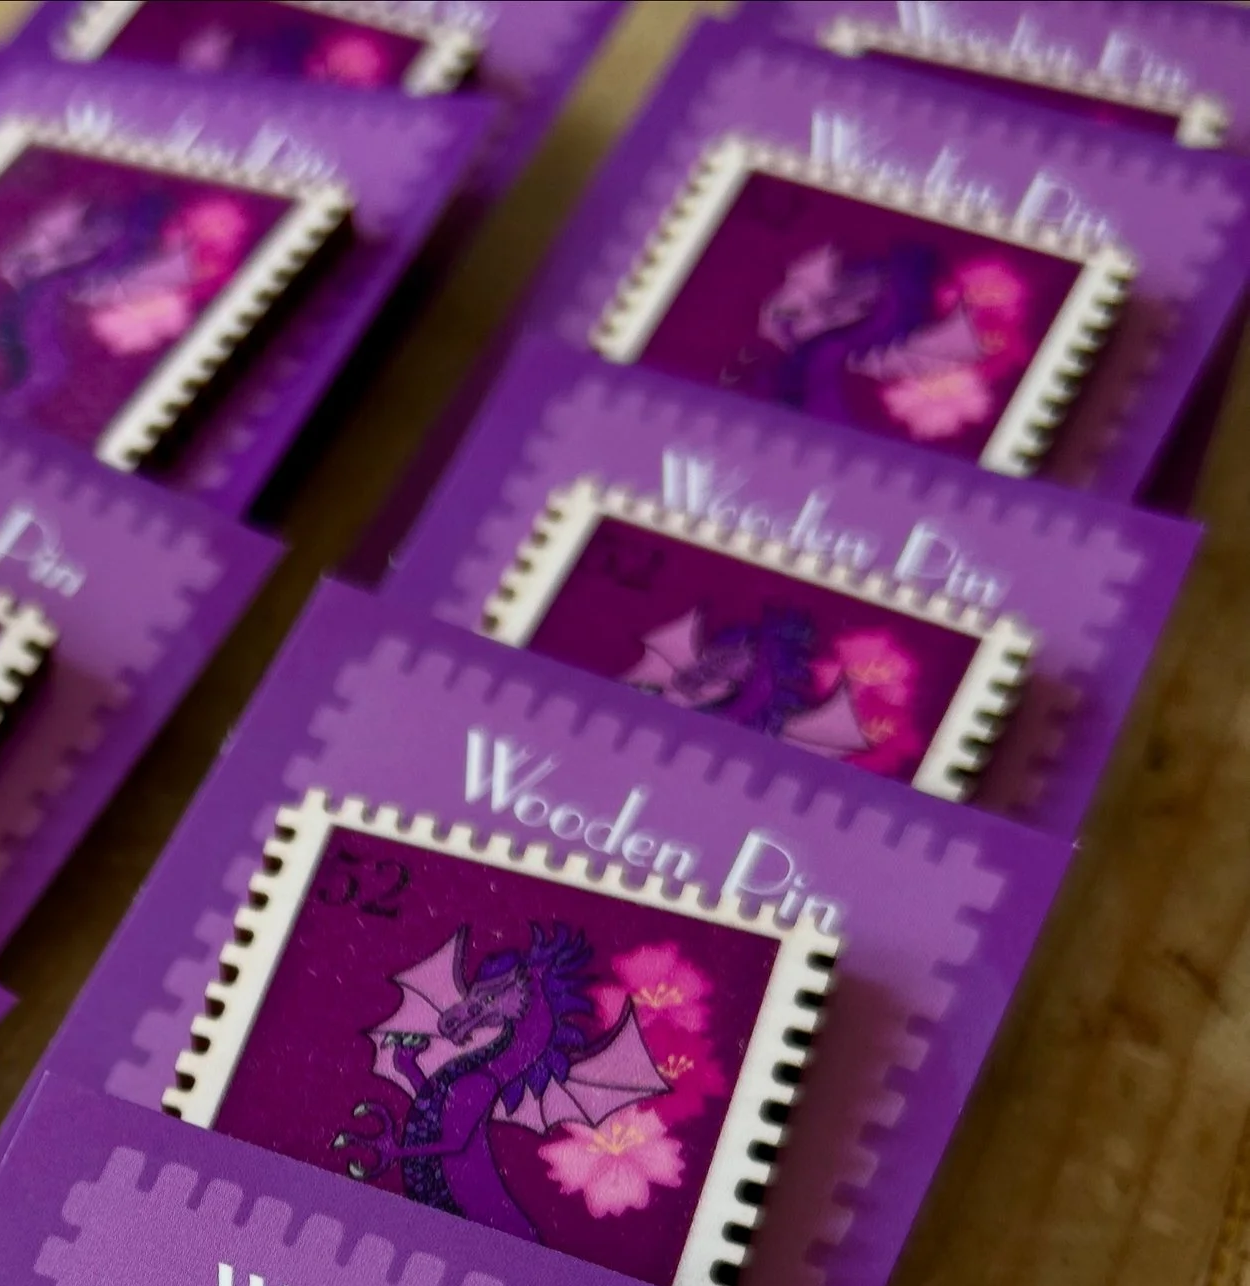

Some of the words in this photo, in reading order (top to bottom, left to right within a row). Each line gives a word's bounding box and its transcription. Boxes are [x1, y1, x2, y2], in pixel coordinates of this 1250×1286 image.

[316, 848, 411, 918] 52
[464, 726, 694, 882] Wooden
[721, 828, 840, 934] Pin
